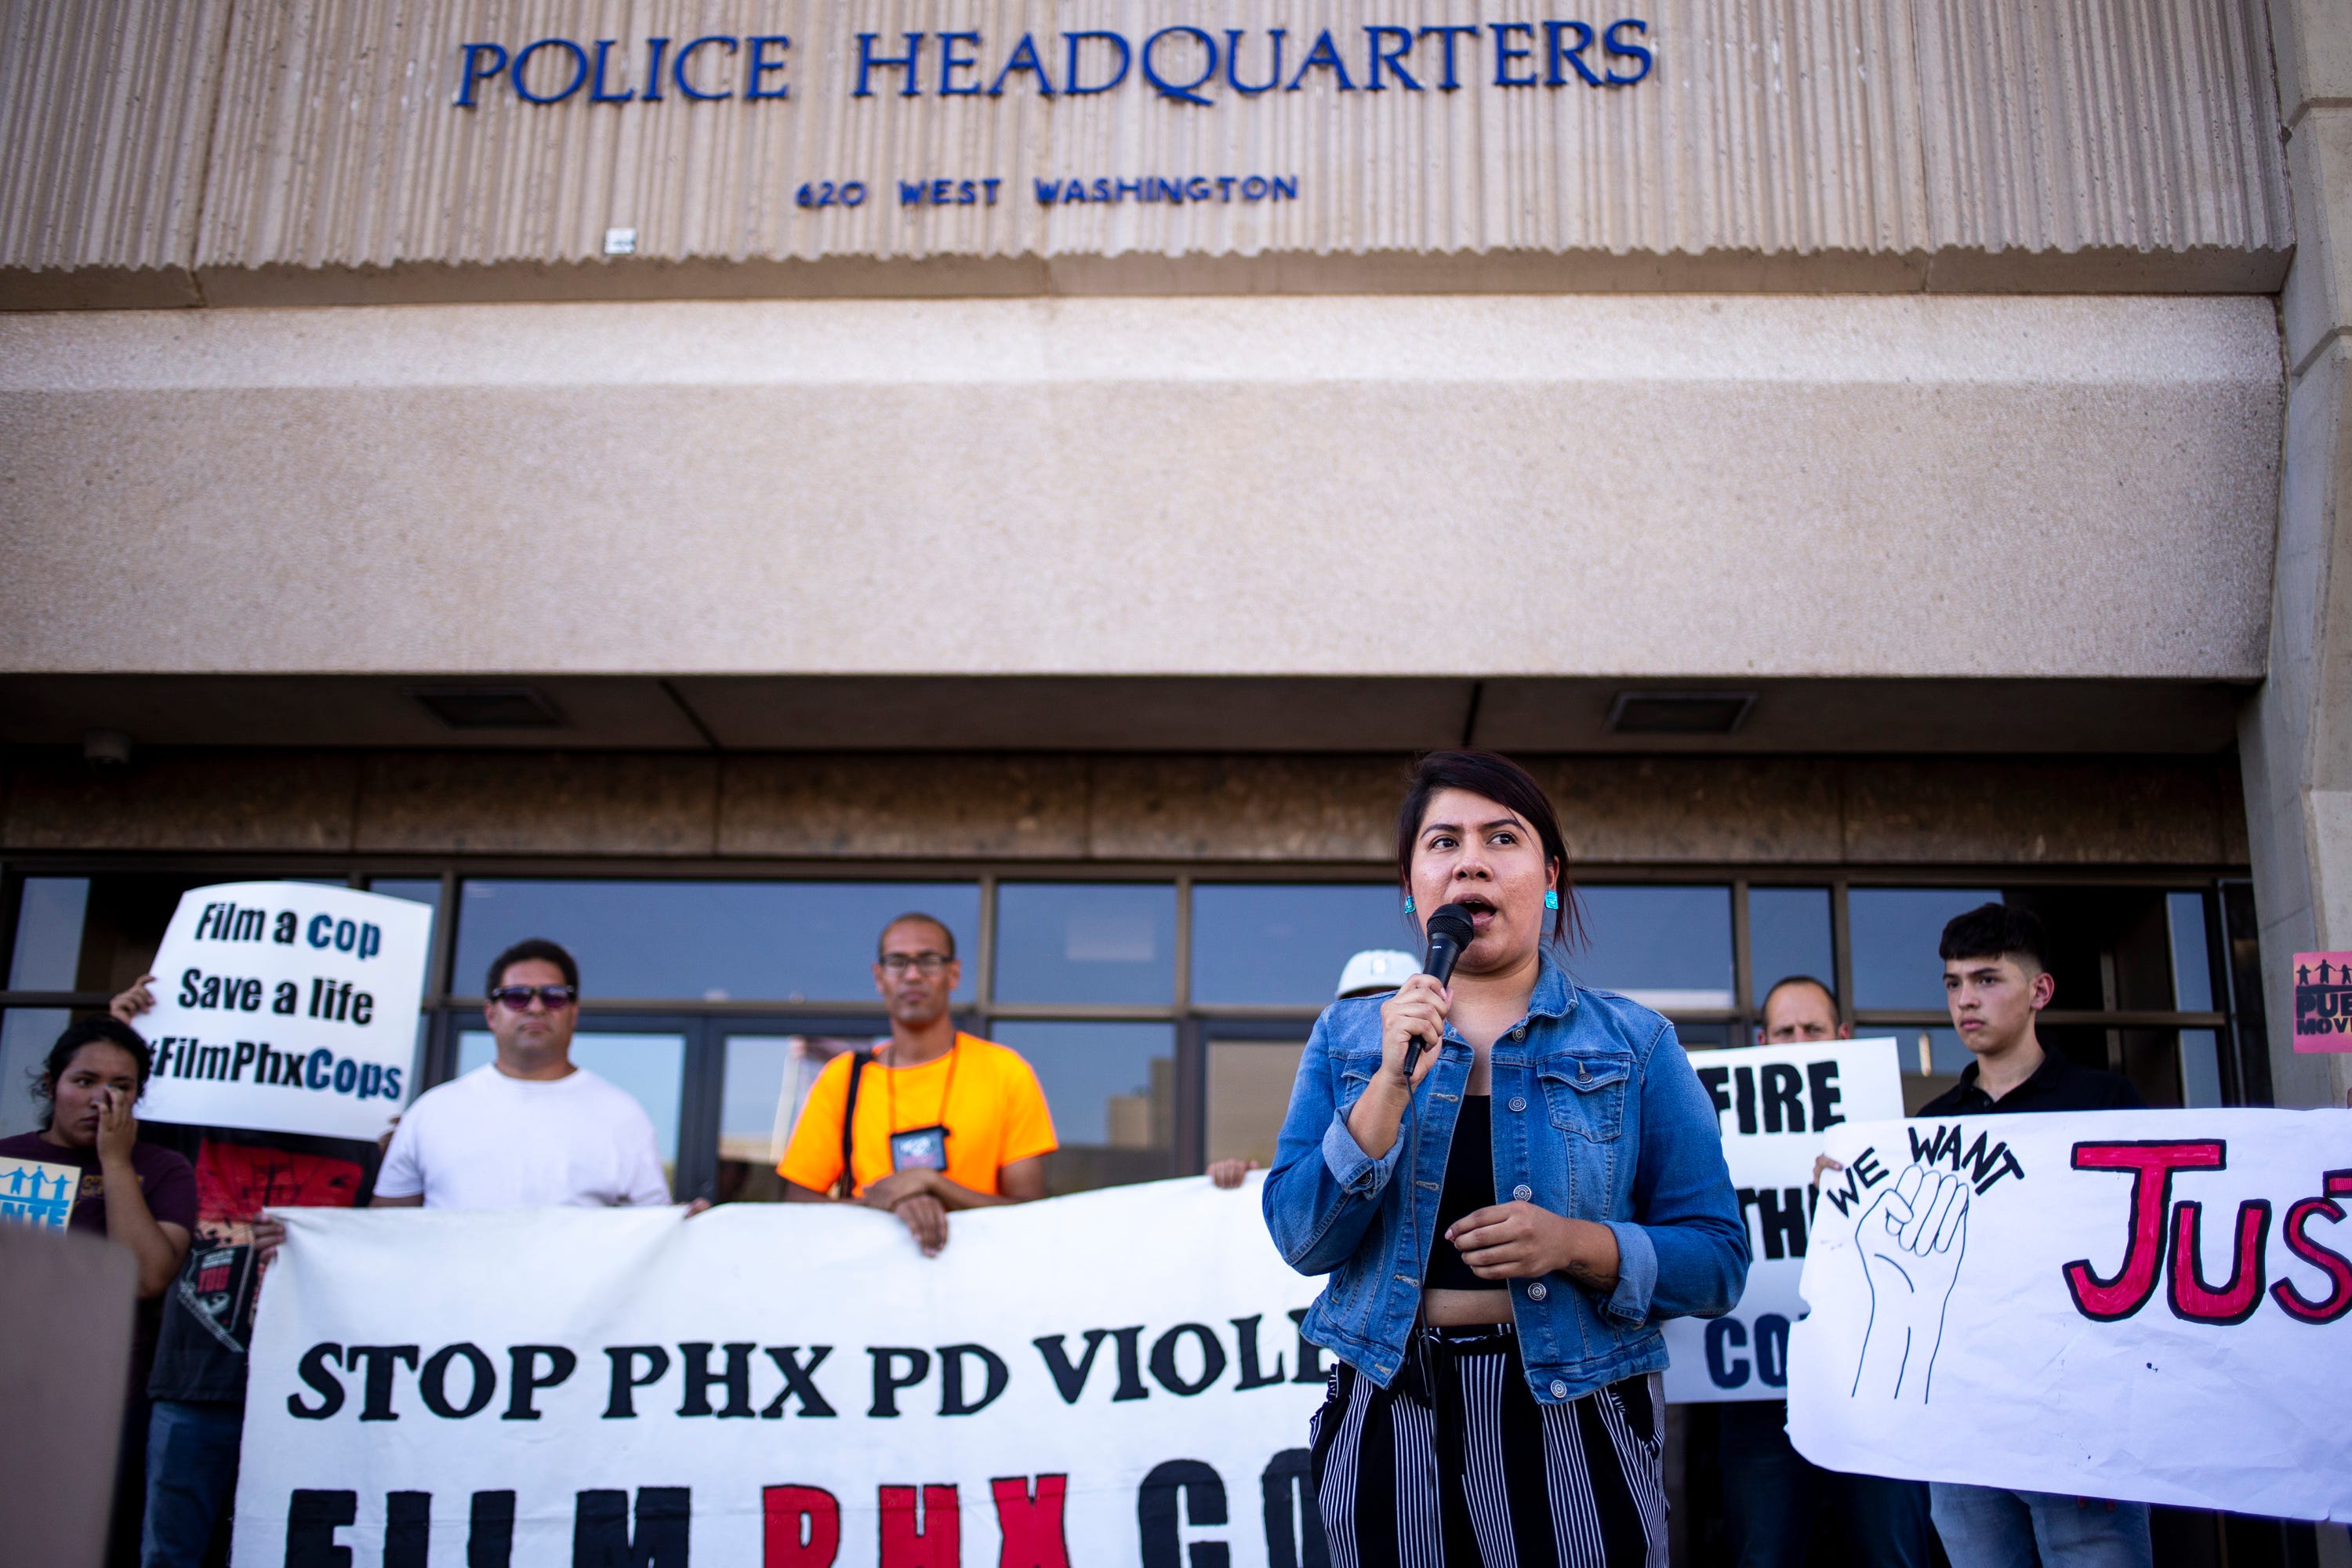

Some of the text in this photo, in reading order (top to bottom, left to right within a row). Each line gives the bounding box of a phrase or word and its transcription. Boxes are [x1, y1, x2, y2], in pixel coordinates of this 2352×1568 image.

[452, 19, 1653, 107] POLICE HEADQUARTERS
[794, 176, 1298, 208] 620 WEST WASHINGTON
[194, 902, 266, 942] Film
[272, 910, 298, 945] a
[177, 968, 373, 1025] Save a life
[1696, 1061, 1846, 1136] FIRE
[1825, 1123, 2025, 1218] WE WANT
[1735, 1184, 1820, 1262] TH
[286, 1341, 576, 1422] STOP
[600, 1341, 838, 1419] PHX
[866, 1343, 1010, 1417] PD
[1704, 1312, 1811, 1389] CO
[762, 1472, 1072, 1568] PHX
